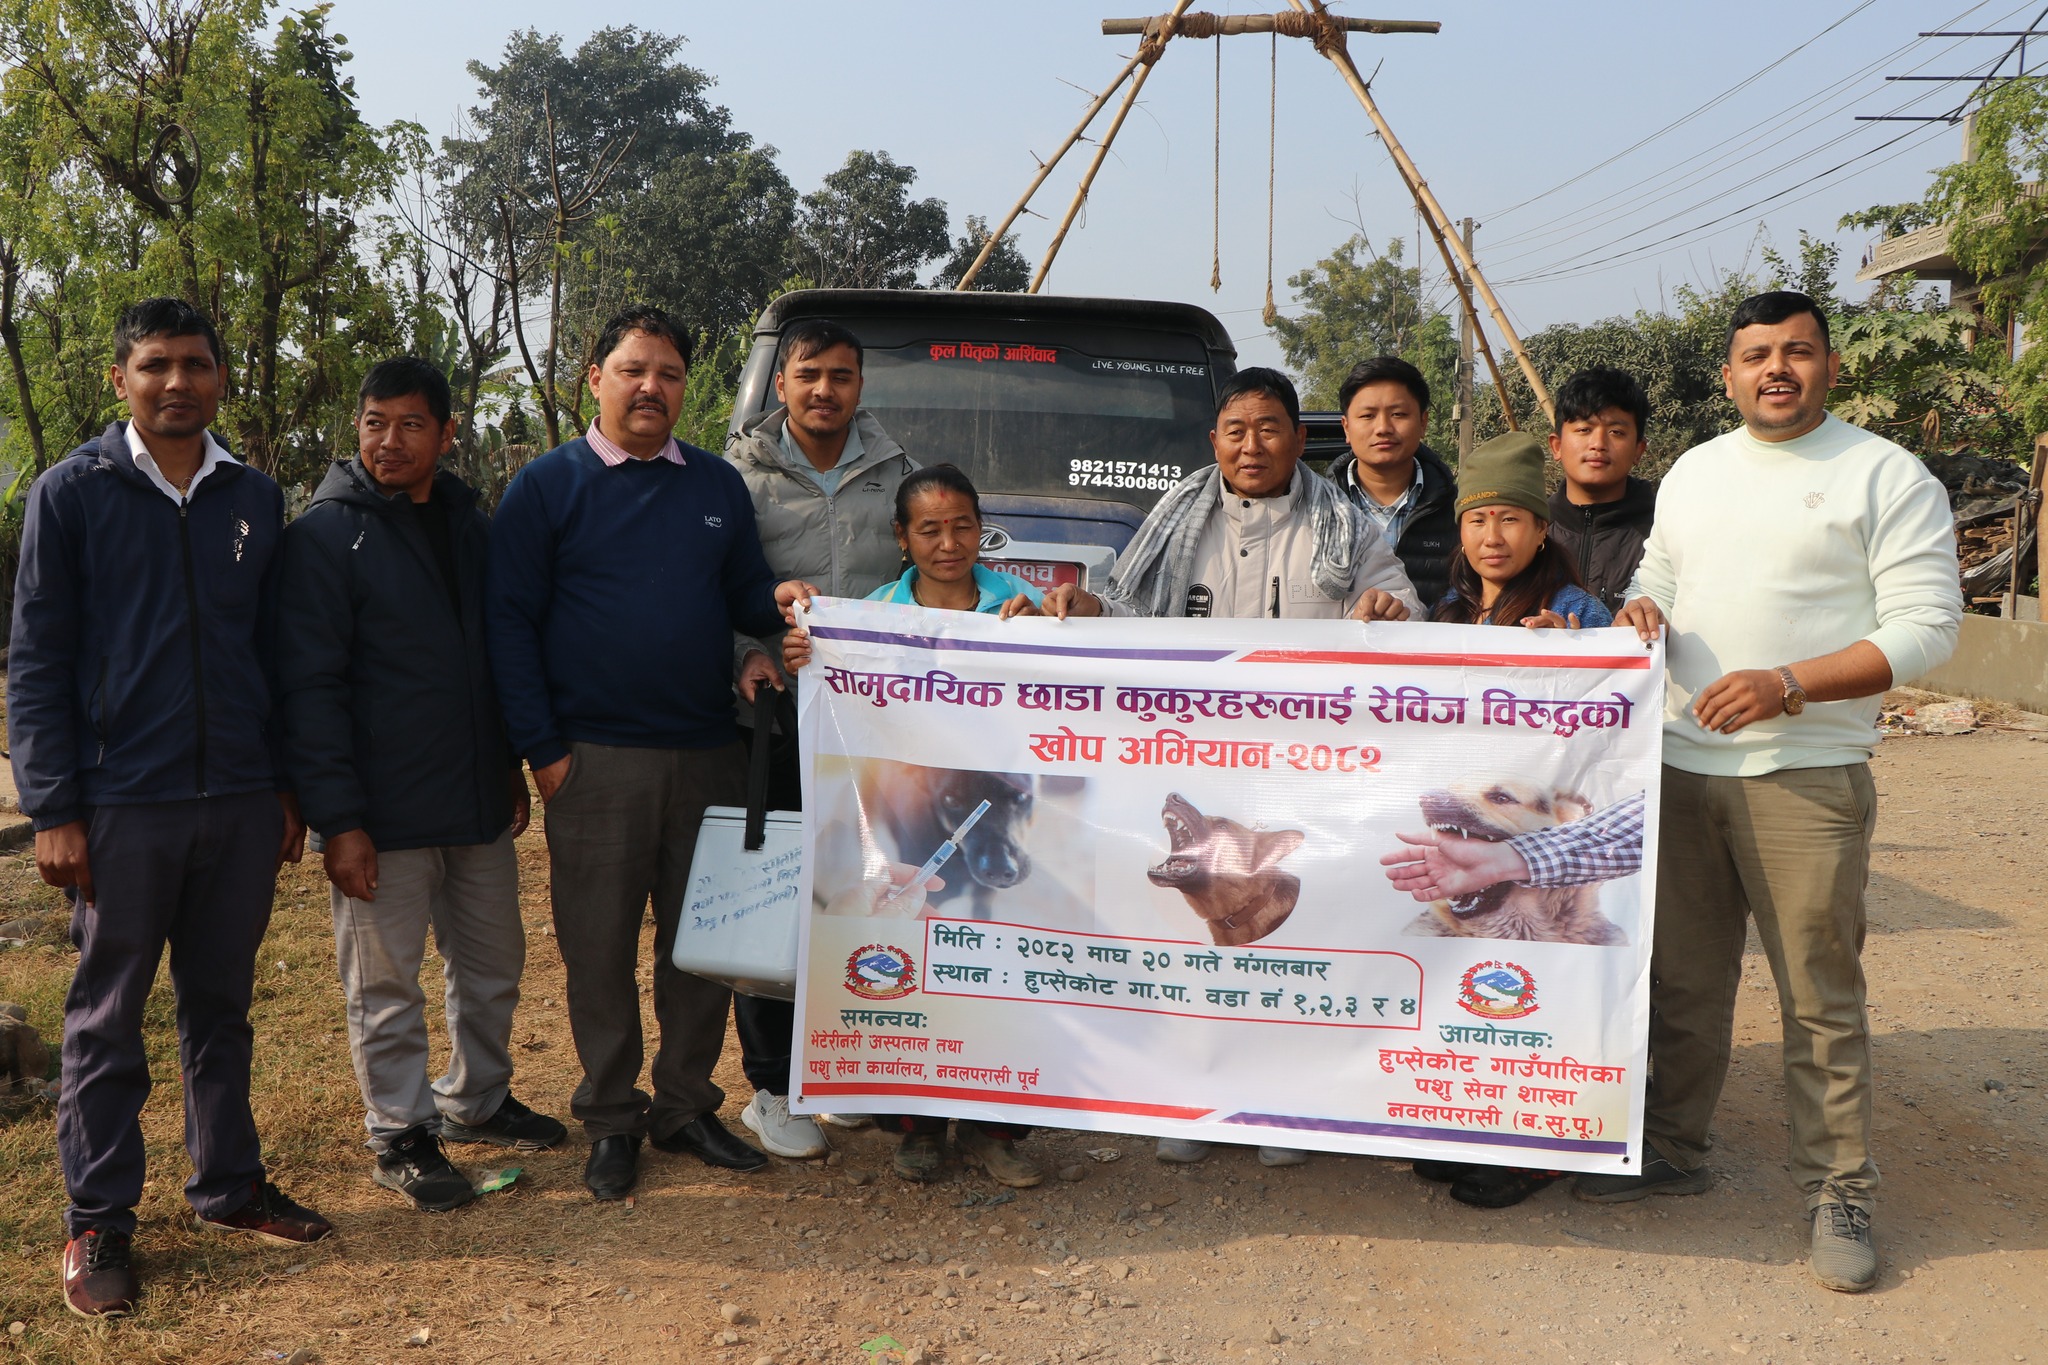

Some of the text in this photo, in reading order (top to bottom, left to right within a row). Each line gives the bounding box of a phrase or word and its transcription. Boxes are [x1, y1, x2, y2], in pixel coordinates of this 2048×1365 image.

[929, 344, 956, 361] कुल
[1092, 360, 1114, 370] LIVE
[1155, 364, 1178, 374] LIVE
[1179, 365, 1205, 376] FREE
[1070, 459, 1182, 478] 9821571413
[704, 515, 722, 523] LATO
[823, 665, 1006, 708] सामुदायिक
[1016, 683, 1105, 712] छाडा
[1368, 685, 1469, 725] रेविज
[1028, 726, 1382, 774] खोप अभियान-२०८२
[933, 924, 986, 950] मिति
[1017, 937, 1074, 964] २०८२
[1087, 945, 1132, 965] माघ
[1142, 950, 1171, 972] २०
[1184, 951, 1223, 973] गते
[1233, 953, 1332, 982] मंगलबार
[932, 963, 993, 985] स्थान
[1024, 969, 1118, 995] हुप्सेकोट
[1128, 980, 1192, 1004] गा.पा.
[1205, 988, 1250, 1008] वडा
[1260, 988, 1283, 1009] नं
[1371, 997, 1390, 1018] र
[1400, 998, 1417, 1015] ४
[869, 1034, 930, 1052] अस्पताल
[936, 1038, 964, 1055] तथा
[809, 1056, 1040, 1092] पशु सेवा कार्यालय, नवलपरासी पूर्व
[1378, 1046, 1627, 1085] हुप्सेकोट गाउँपालिका
[1414, 1077, 1578, 1108] पशु सेवा शाखा
[1386, 1102, 1503, 1128] नवलपरासी
